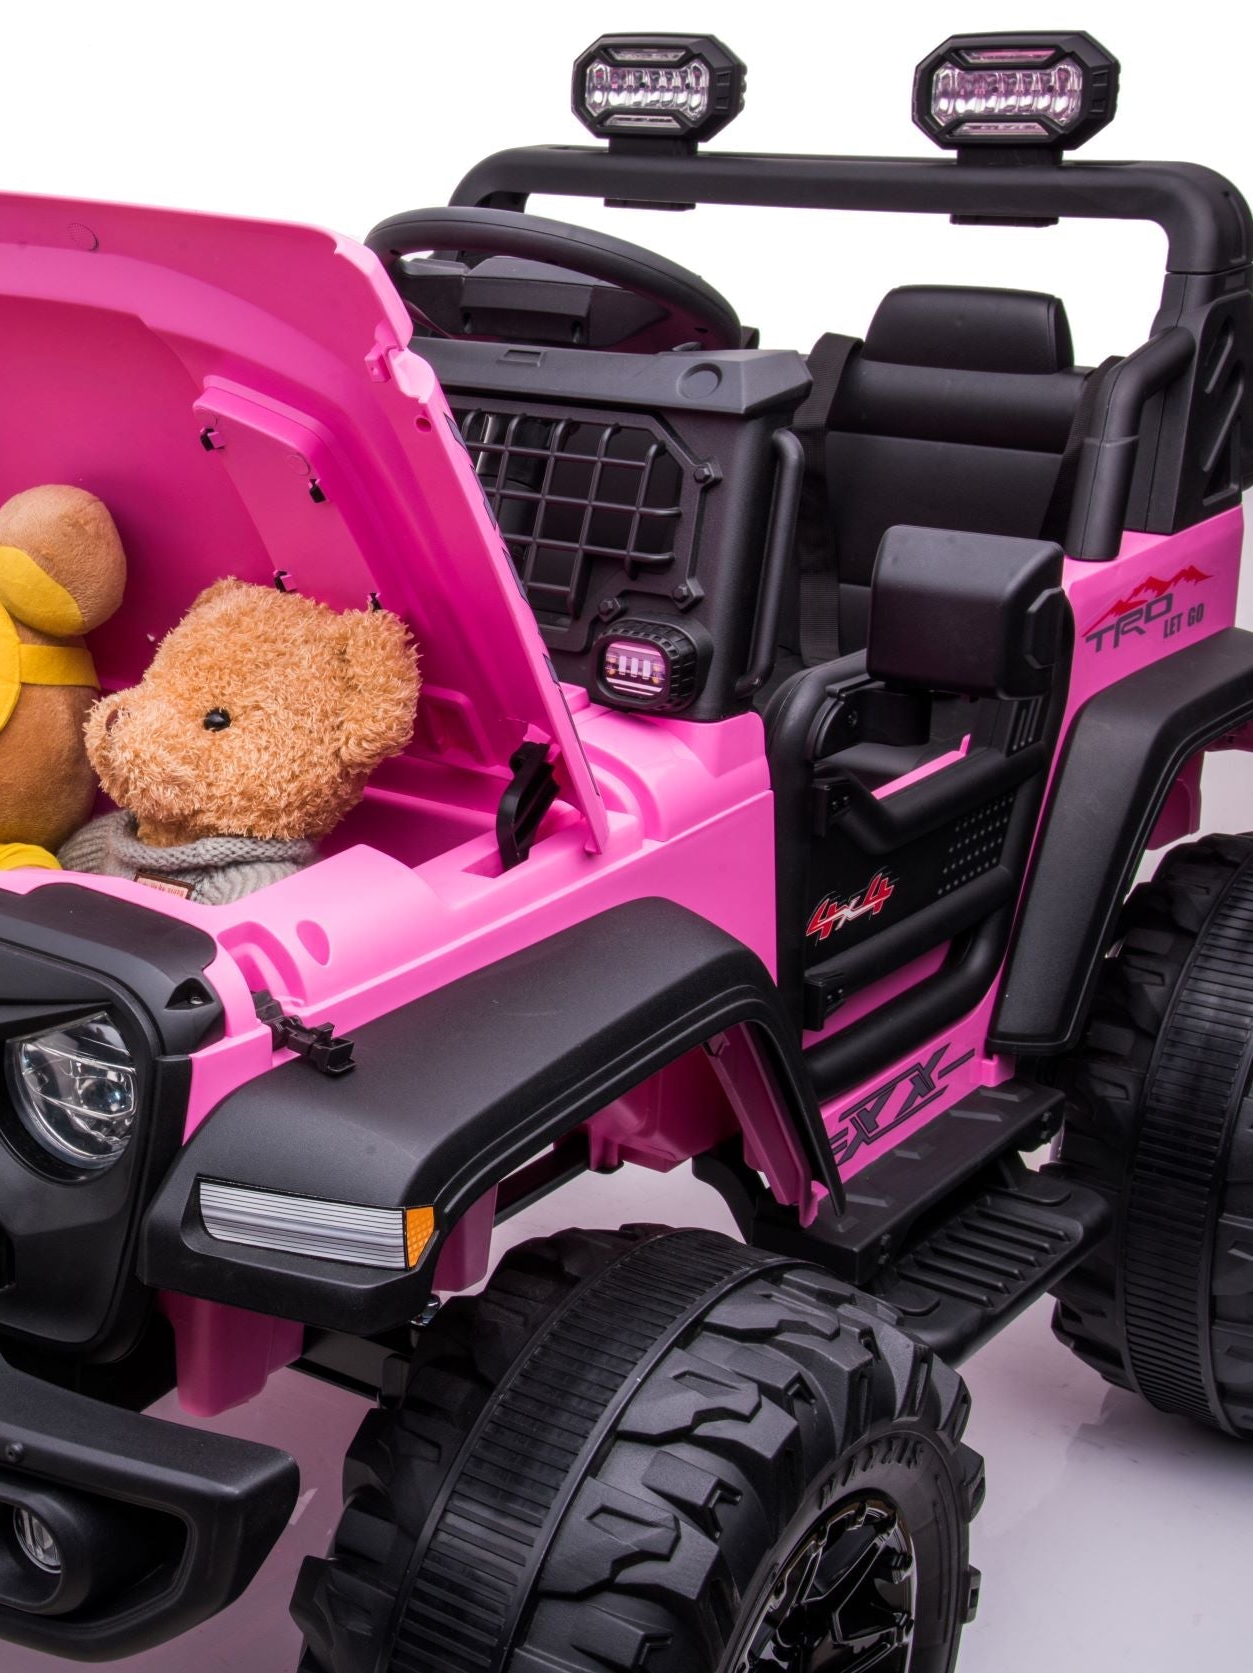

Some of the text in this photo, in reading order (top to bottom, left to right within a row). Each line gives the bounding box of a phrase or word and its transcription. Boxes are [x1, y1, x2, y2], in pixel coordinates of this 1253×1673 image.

[1085, 592, 1174, 653] TRD
[1163, 602, 1205, 640] LET GO
